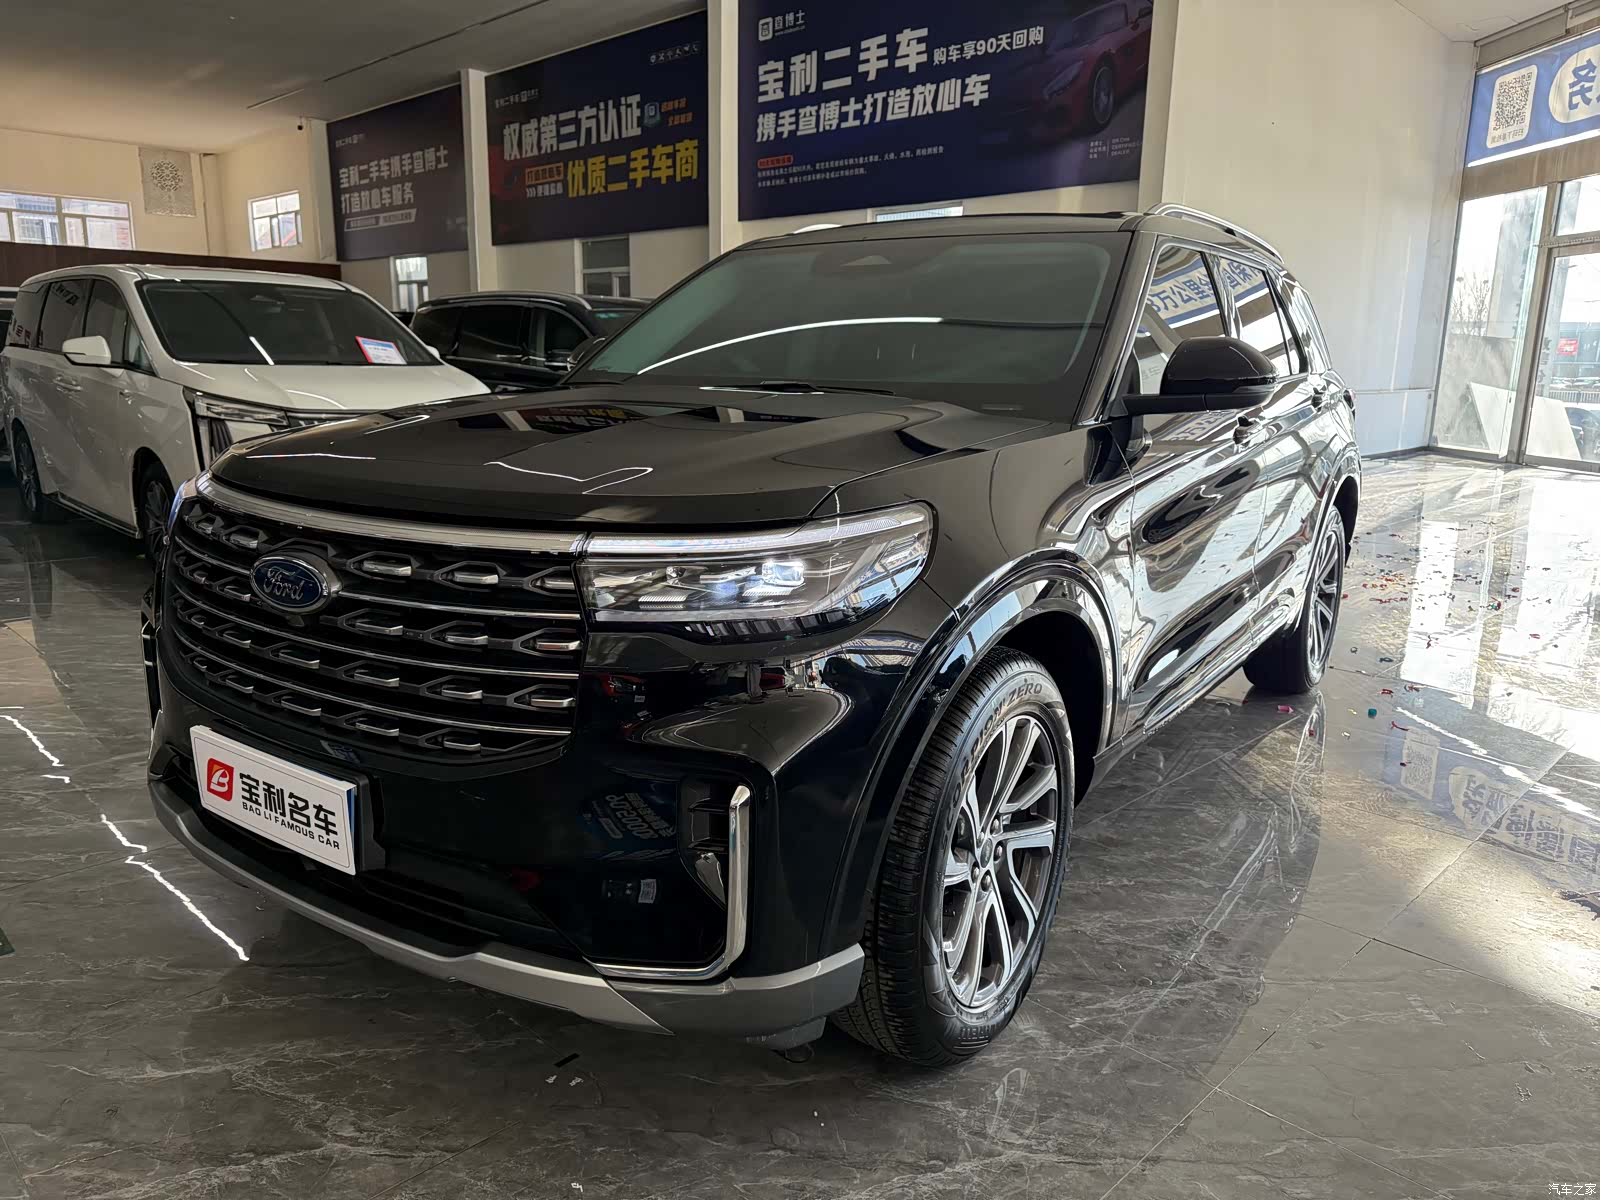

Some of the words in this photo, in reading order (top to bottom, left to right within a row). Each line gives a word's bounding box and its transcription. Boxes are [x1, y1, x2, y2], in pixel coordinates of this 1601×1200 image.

[757, 27, 929, 103] 宝利二手车
[932, 26, 1044, 66] 购车享90天回购
[503, 94, 642, 161] 权威第三方认证
[756, 73, 991, 142] 携手查博士打造放心车
[567, 139, 699, 198] 优质二手车商
[263, 566, 305, 600] Ford
[1008, 682, 1042, 702] ZERO
[239, 772, 338, 836] 宝利名车
[242, 801, 261, 816] BAO
[263, 811, 272, 821] LI
[274, 816, 315, 840] FAMOUS
[318, 834, 340, 850] CAR
